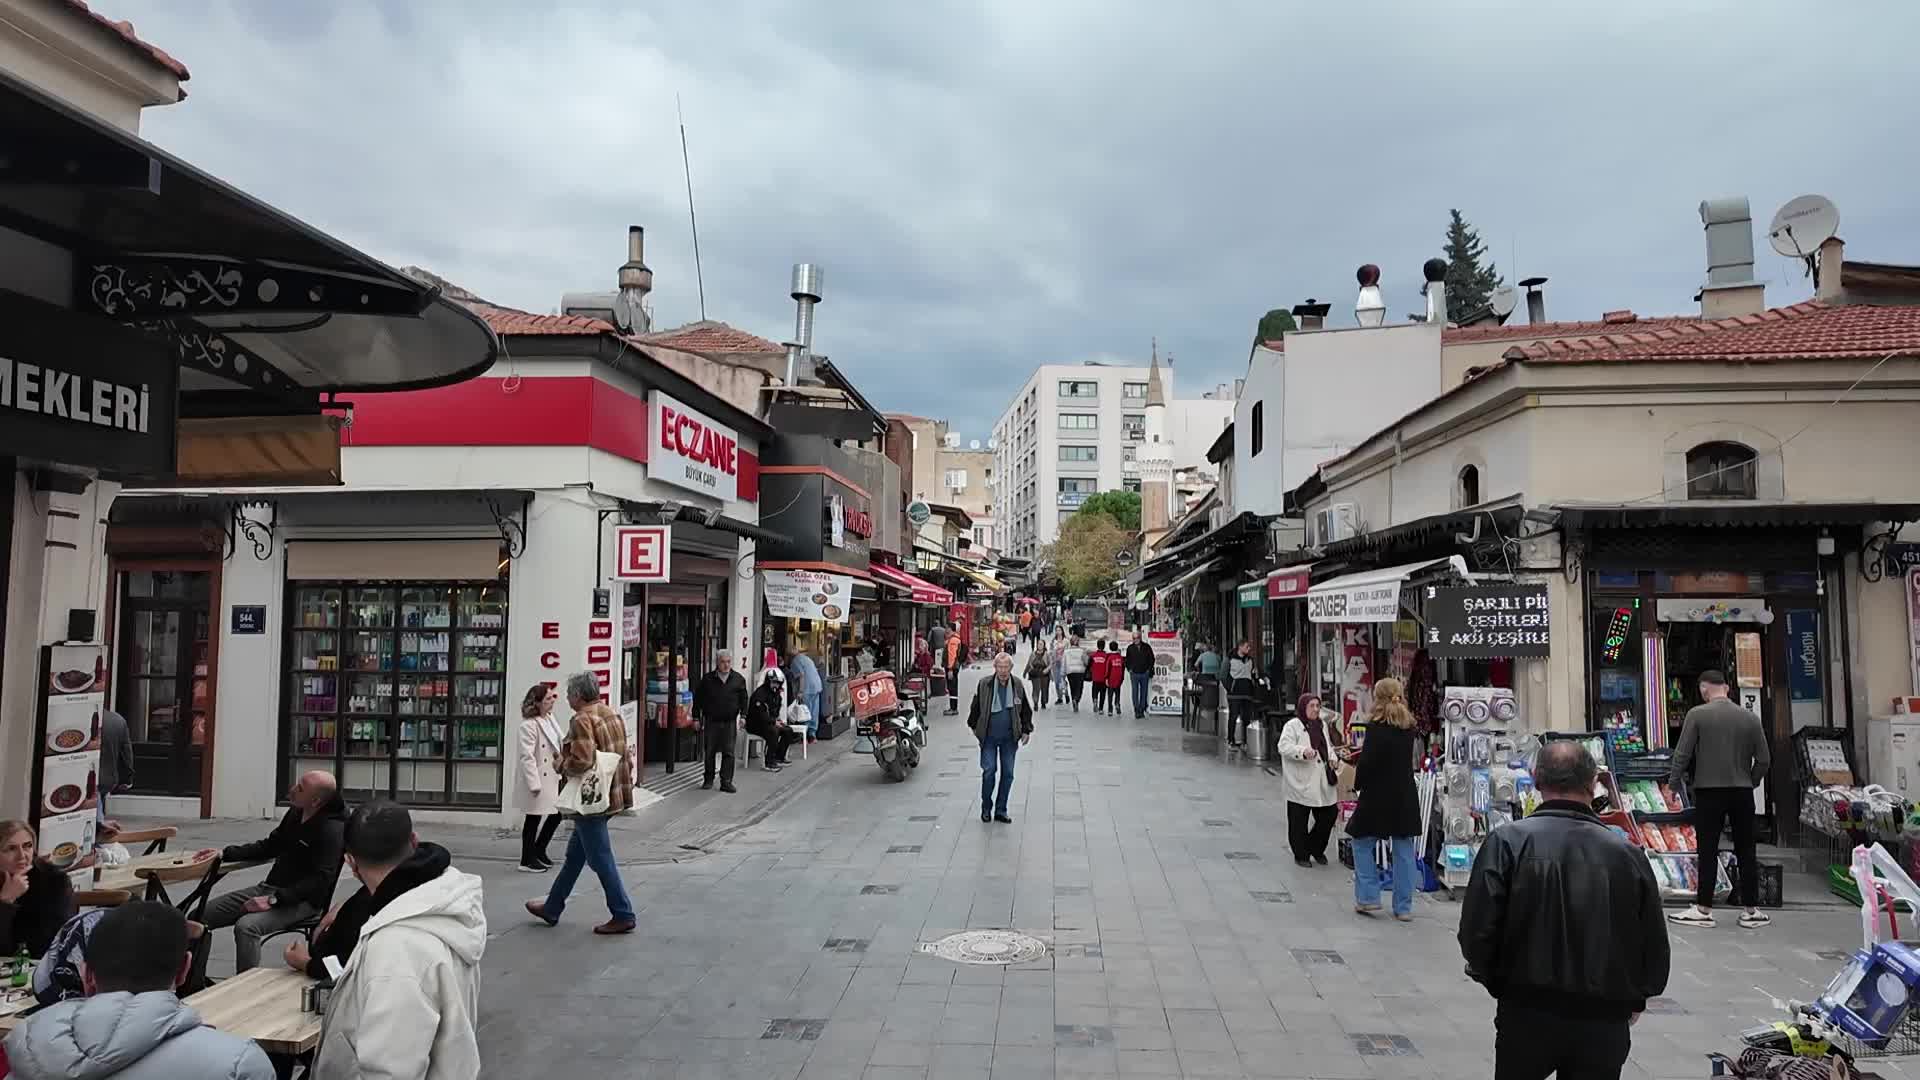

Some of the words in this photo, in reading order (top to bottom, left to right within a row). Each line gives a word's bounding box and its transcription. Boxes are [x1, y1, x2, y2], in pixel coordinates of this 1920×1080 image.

[662, 405, 736, 476] ECZANE
[686, 465, 703, 482] BÜYÜK
[629, 537, 653, 570] E
[1309, 594, 1348, 617] CENGER
[1463, 597, 1521, 614] ŞARJLI
[1450, 629, 1484, 645] AKÜ
[1152, 666, 1168, 677] 00
[1151, 695, 1173, 707] 450
[1745, 695, 1756, 712] Pa
